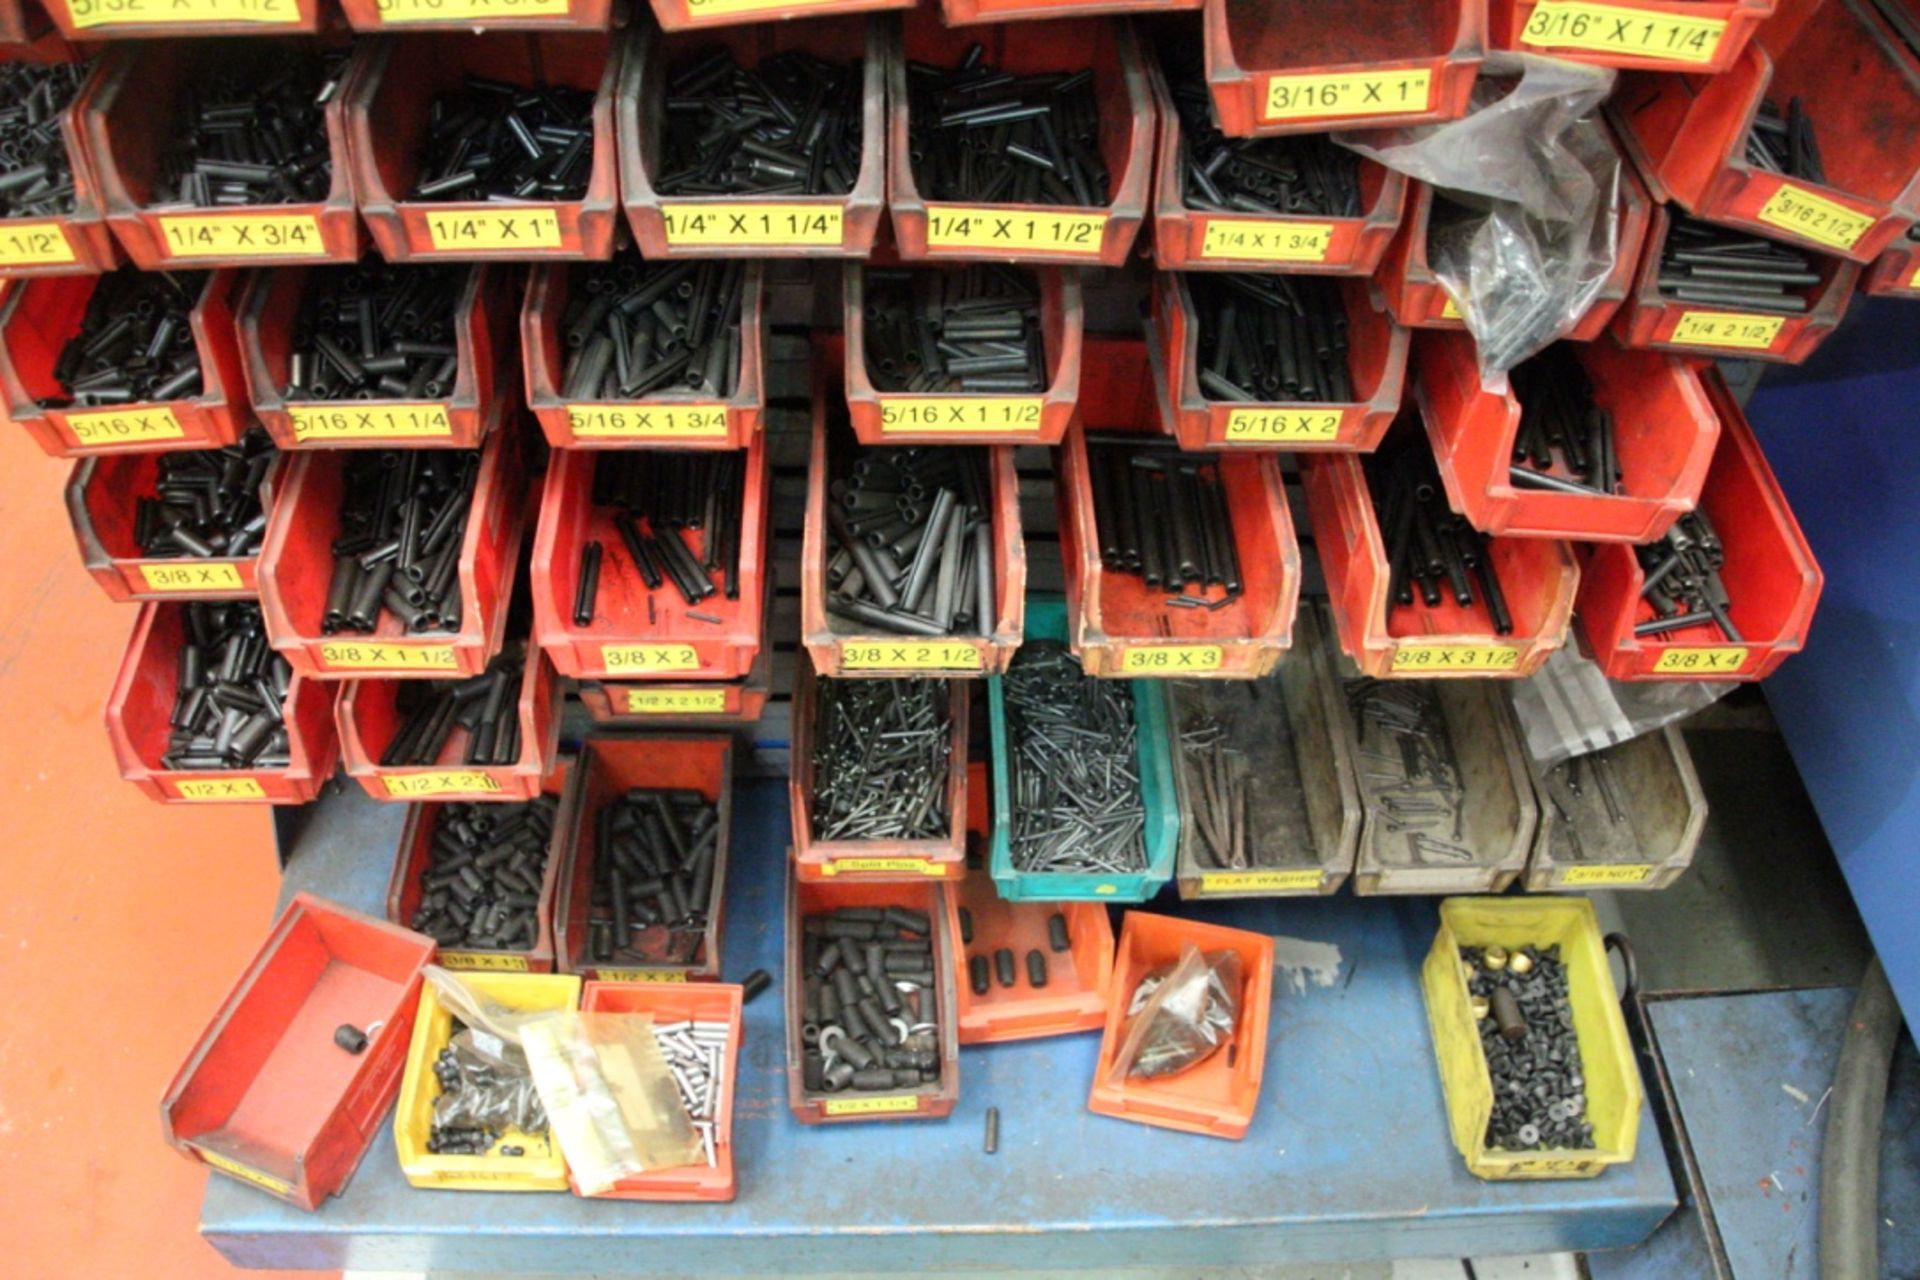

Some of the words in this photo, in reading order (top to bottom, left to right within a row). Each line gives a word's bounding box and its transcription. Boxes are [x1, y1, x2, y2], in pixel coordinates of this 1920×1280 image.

[1528, 9, 1602, 38] 3/16"
[1611, 19, 1632, 39] X
[1640, 23, 1654, 44] 1
[1665, 25, 1722, 51] 1/4"
[1271, 83, 1350, 108] 3/16"
[1362, 81, 1383, 104] X
[1397, 79, 1425, 102] 1"
[664, 213, 717, 235] 1/4"
[729, 214, 748, 234] X
[760, 214, 772, 234] 1
[787, 213, 839, 235] 1/4"
[1776, 199, 1811, 221] 3/16
[1812, 212, 1828, 227] 2
[1828, 218, 1853, 238] 1/2
[169, 225, 221, 246] 1/4"
[232, 225, 254, 246] X
[262, 224, 315, 245] 3/4"
[433, 218, 487, 241] 1/4"
[499, 218, 519, 240] X
[529, 218, 555, 239] 1"
[930, 217, 983, 238] 1/4"
[993, 219, 1013, 240] X
[1025, 220, 1036, 240] 1
[1051, 221, 1103, 243] 1/2"
[9, 233, 59, 254] 1/2"
[1217, 231, 1246, 248] 1/4
[1251, 233, 1266, 248] X
[1274, 233, 1283, 248] 1
[1288, 234, 1319, 250] 3/4
[1689, 321, 1715, 335] 1/4
[1723, 323, 1736, 337] 2
[1740, 324, 1767, 339] 1/2
[293, 412, 348, 431] 5/16
[356, 412, 376, 430] X
[385, 412, 397, 430] 1
[411, 410, 449, 430] 1/4
[569, 411, 627, 429] 5/16
[636, 412, 654, 428] X
[666, 412, 676, 428] 1
[687, 411, 727, 428] 3/4
[882, 406, 939, 425] 5/16
[949, 406, 966, 424] X
[977, 406, 988, 423] 1
[1001, 404, 1040, 423] 1/2
[72, 417, 129, 439] 5/16
[136, 416, 154, 432] X
[162, 414, 176, 431] 1
[1231, 415, 1288, 434] 5/16
[1295, 416, 1313, 433] X
[1321, 415, 1337, 433] 2
[153, 569, 192, 585] 3/8
[197, 569, 215, 583] X
[223, 568, 233, 582] 1
[323, 646, 362, 663] 3/8
[370, 647, 387, 662] X
[397, 648, 407, 662] 1
[420, 648, 456, 665] 1/2
[607, 650, 646, 667] 3/8
[655, 650, 670, 664] X
[679, 649, 695, 664] 2
[843, 647, 881, 663] 3/8
[891, 648, 908, 663] X
[916, 648, 931, 663] 2
[941, 647, 978, 663] 1/2
[1131, 650, 1169, 667] 3/8
[1177, 651, 1193, 666] X
[1202, 650, 1217, 666] 3
[1395, 650, 1431, 665] 3/8
[1437, 651, 1454, 664] X
[1460, 650, 1475, 664] 3
[1484, 650, 1518, 665] 1/2
[1663, 652, 1696, 668] 3/8
[1704, 653, 1720, 667] X
[1726, 653, 1740, 668] 4
[637, 695, 659, 706] 1/2
[665, 696, 674, 705] X
[679, 696, 689, 706] 2
[183, 782, 216, 797] 1/2
[223, 782, 241, 795] X
[247, 781, 258, 794] 1
[399, 777, 431, 792] 1/2
[438, 776, 454, 787] X
[460, 774, 475, 787] 2
[481, 955, 496, 967] X
